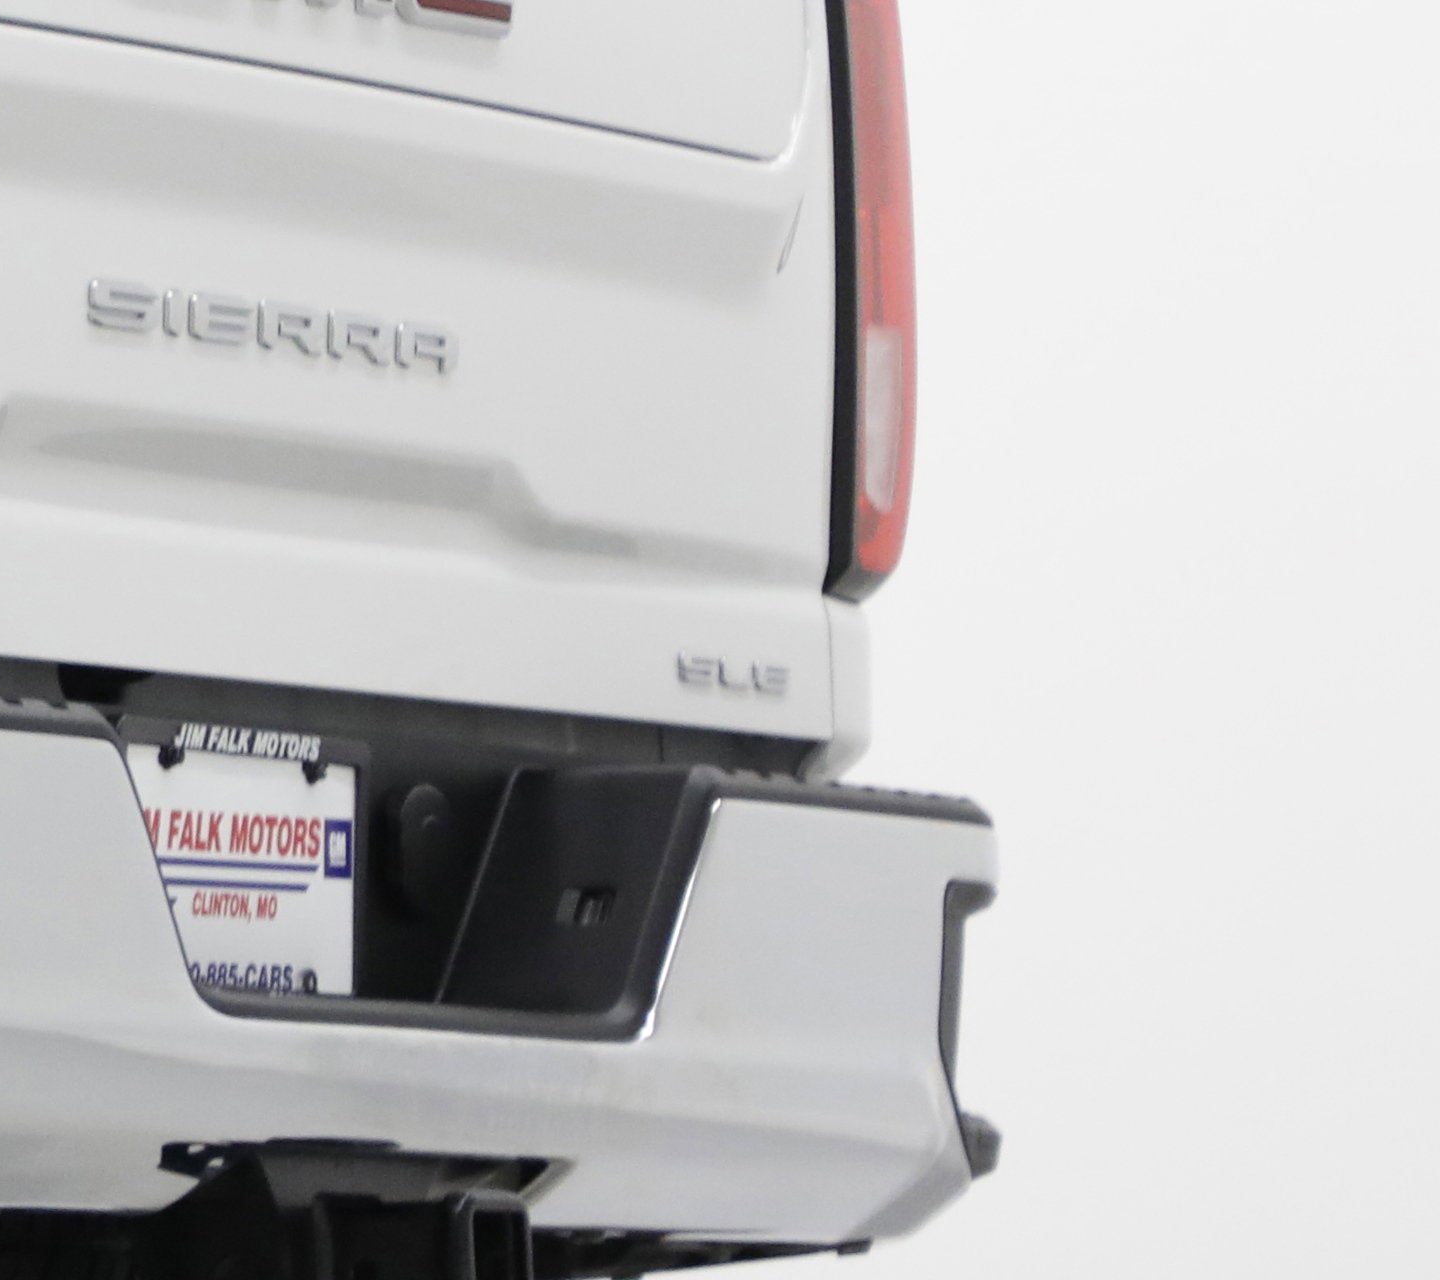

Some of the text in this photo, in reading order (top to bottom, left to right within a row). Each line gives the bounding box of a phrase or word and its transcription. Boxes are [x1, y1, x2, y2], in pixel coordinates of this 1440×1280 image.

[88, 278, 459, 375] SIERRA
[677, 649, 790, 697] SLE
[174, 723, 322, 762] JIM FALK MOTORS
[167, 808, 225, 853] FALK
[229, 812, 322, 859] MOTORS
[192, 889, 278, 923] CLINTON, MO
